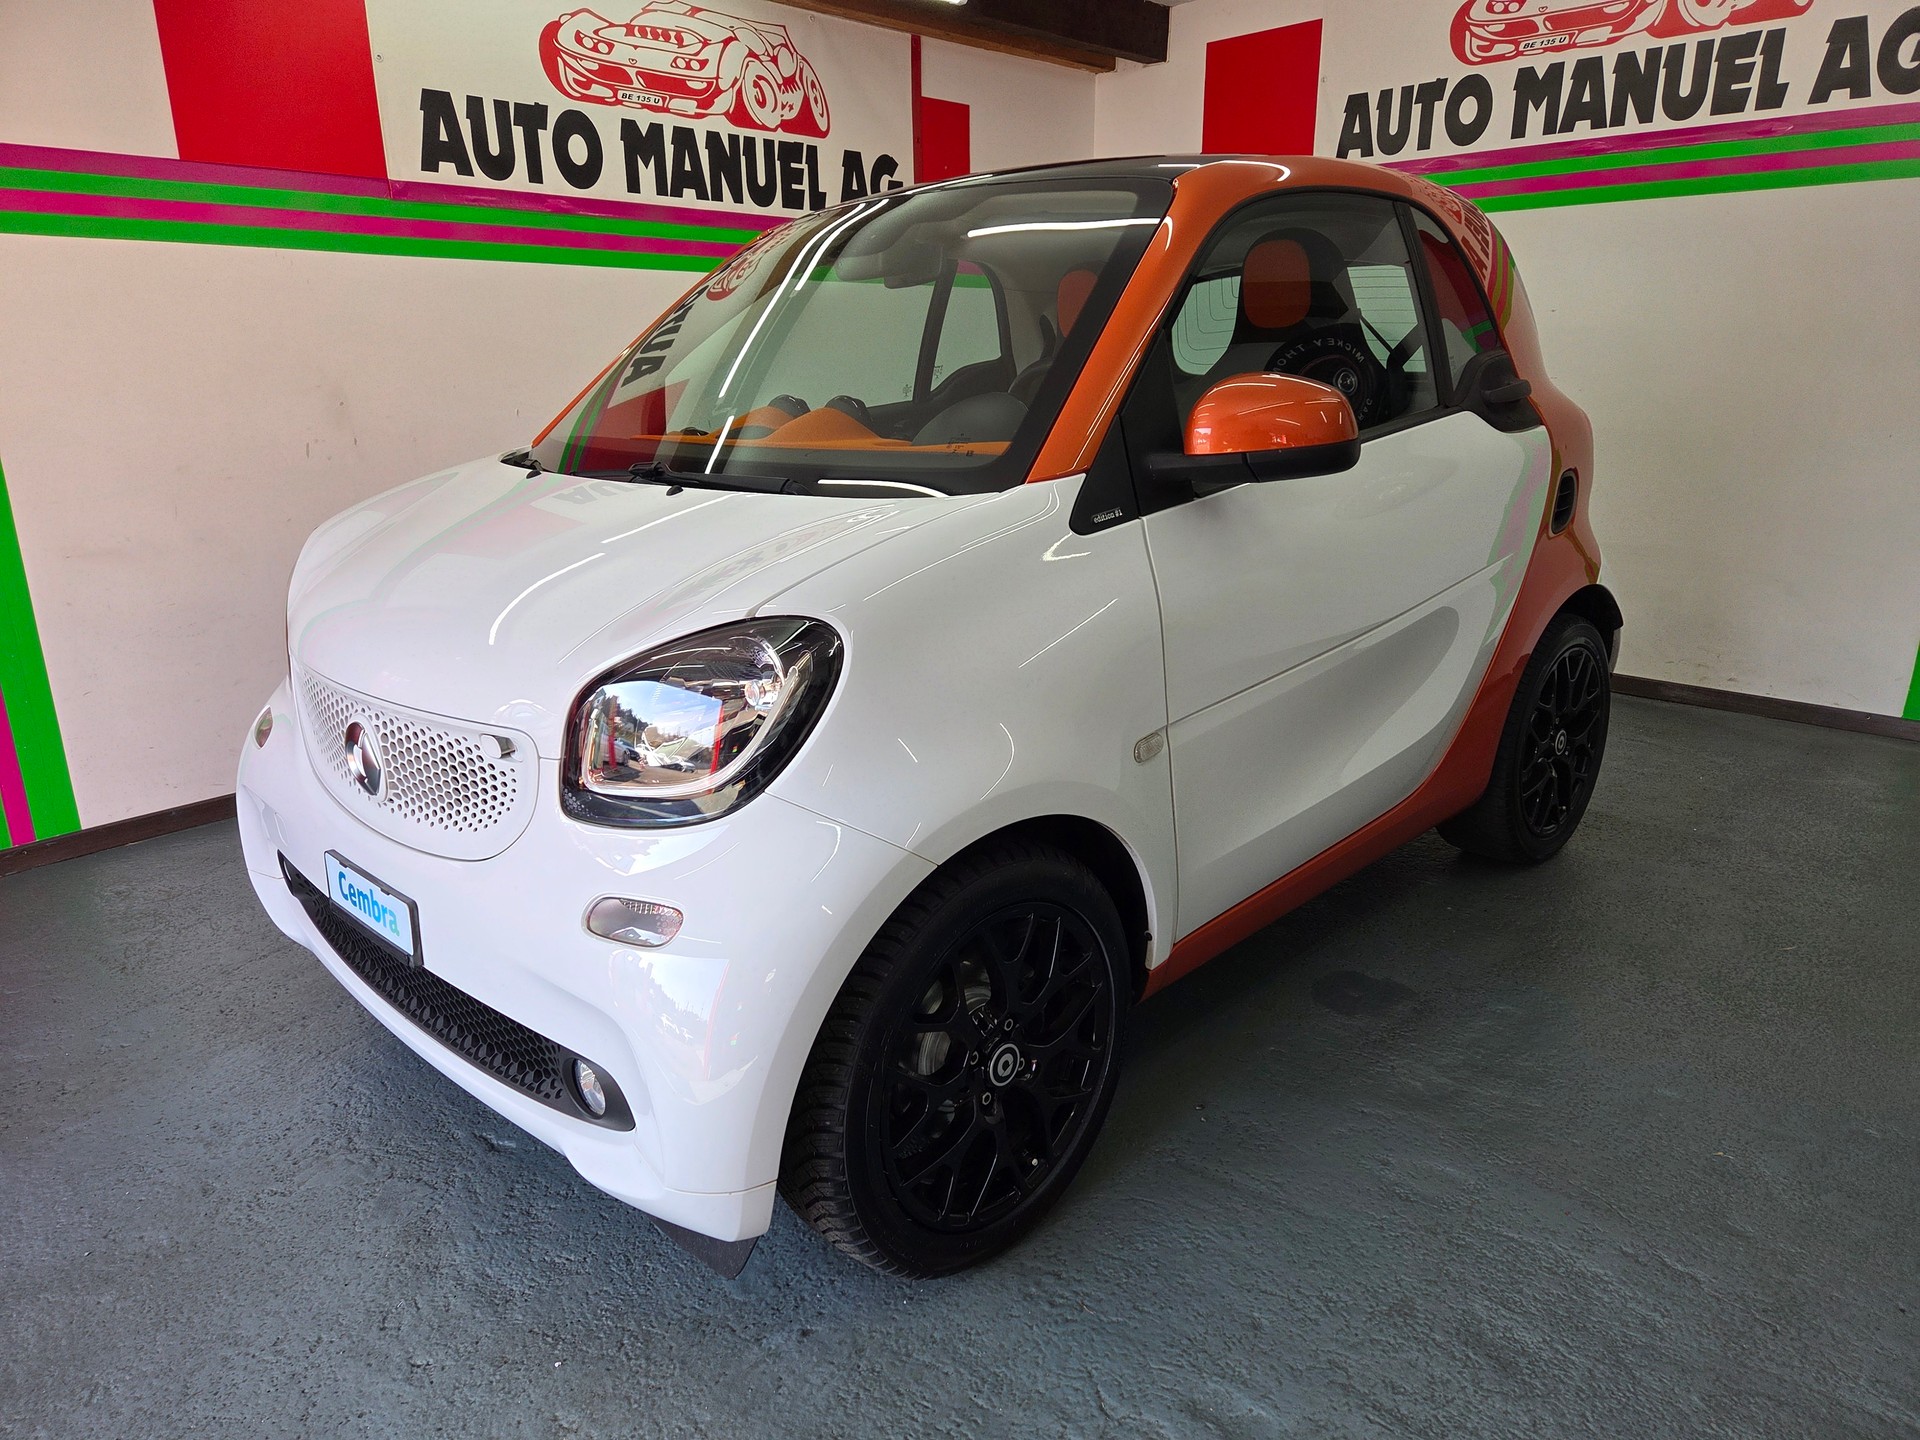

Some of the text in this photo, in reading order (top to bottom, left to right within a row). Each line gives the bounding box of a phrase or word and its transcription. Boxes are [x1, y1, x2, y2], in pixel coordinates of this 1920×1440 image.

[1523, 41, 1537, 49] BE
[1540, 38, 1556, 46] 135
[637, 95, 651, 103] 135
[1336, 5, 1920, 159] AUTO MANUEL AG
[420, 88, 904, 210] AUTO MANUEL AG
[338, 871, 400, 936] Cembra
